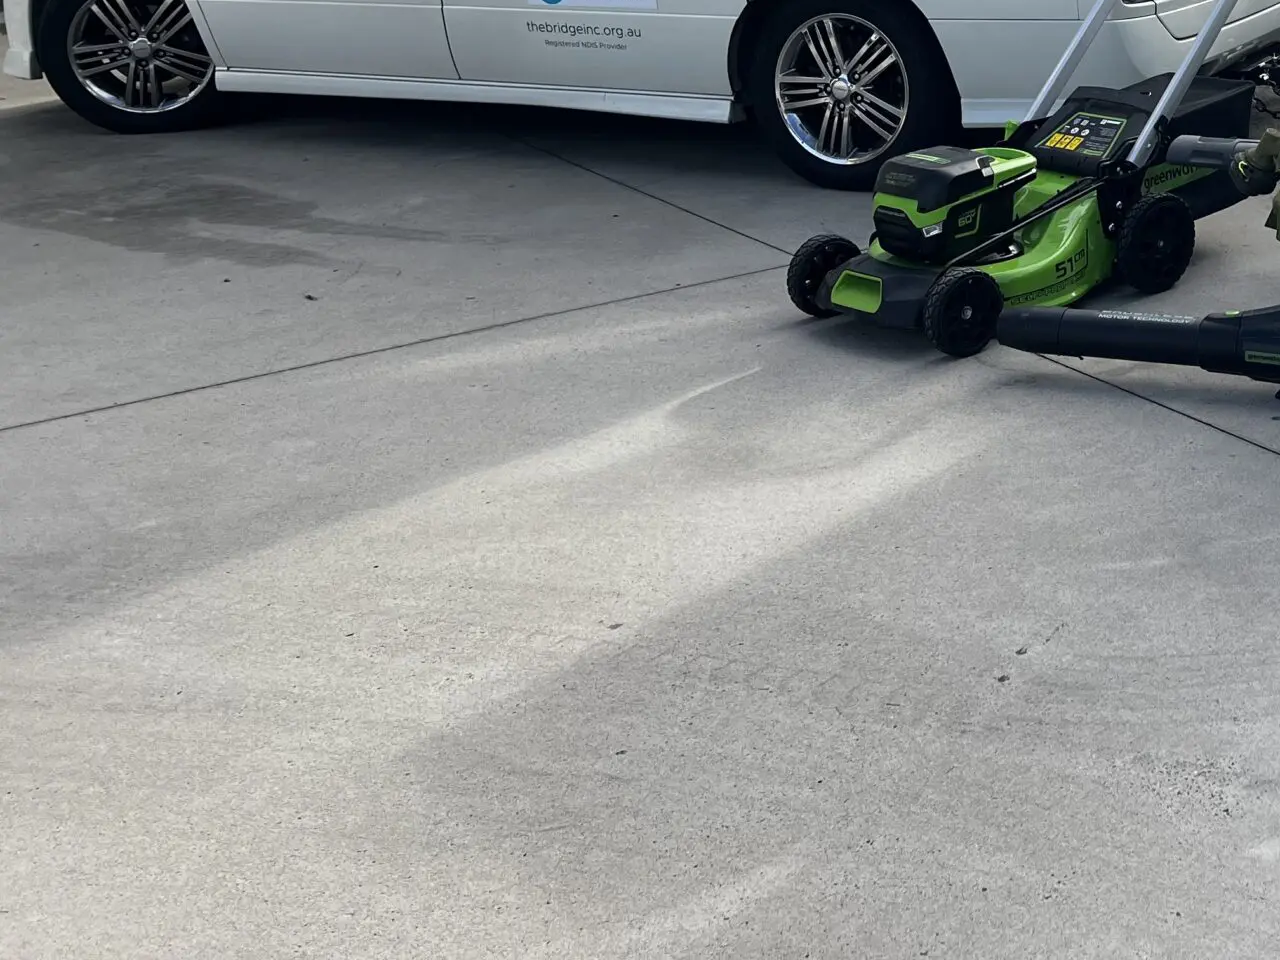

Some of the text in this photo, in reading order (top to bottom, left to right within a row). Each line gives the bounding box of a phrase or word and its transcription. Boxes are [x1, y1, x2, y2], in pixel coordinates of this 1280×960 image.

[526, 21, 642, 38] thebridgeinc.org.au
[544, 40, 627, 51] Registered NDIS Provider
[1143, 163, 1198, 193] greenwor
